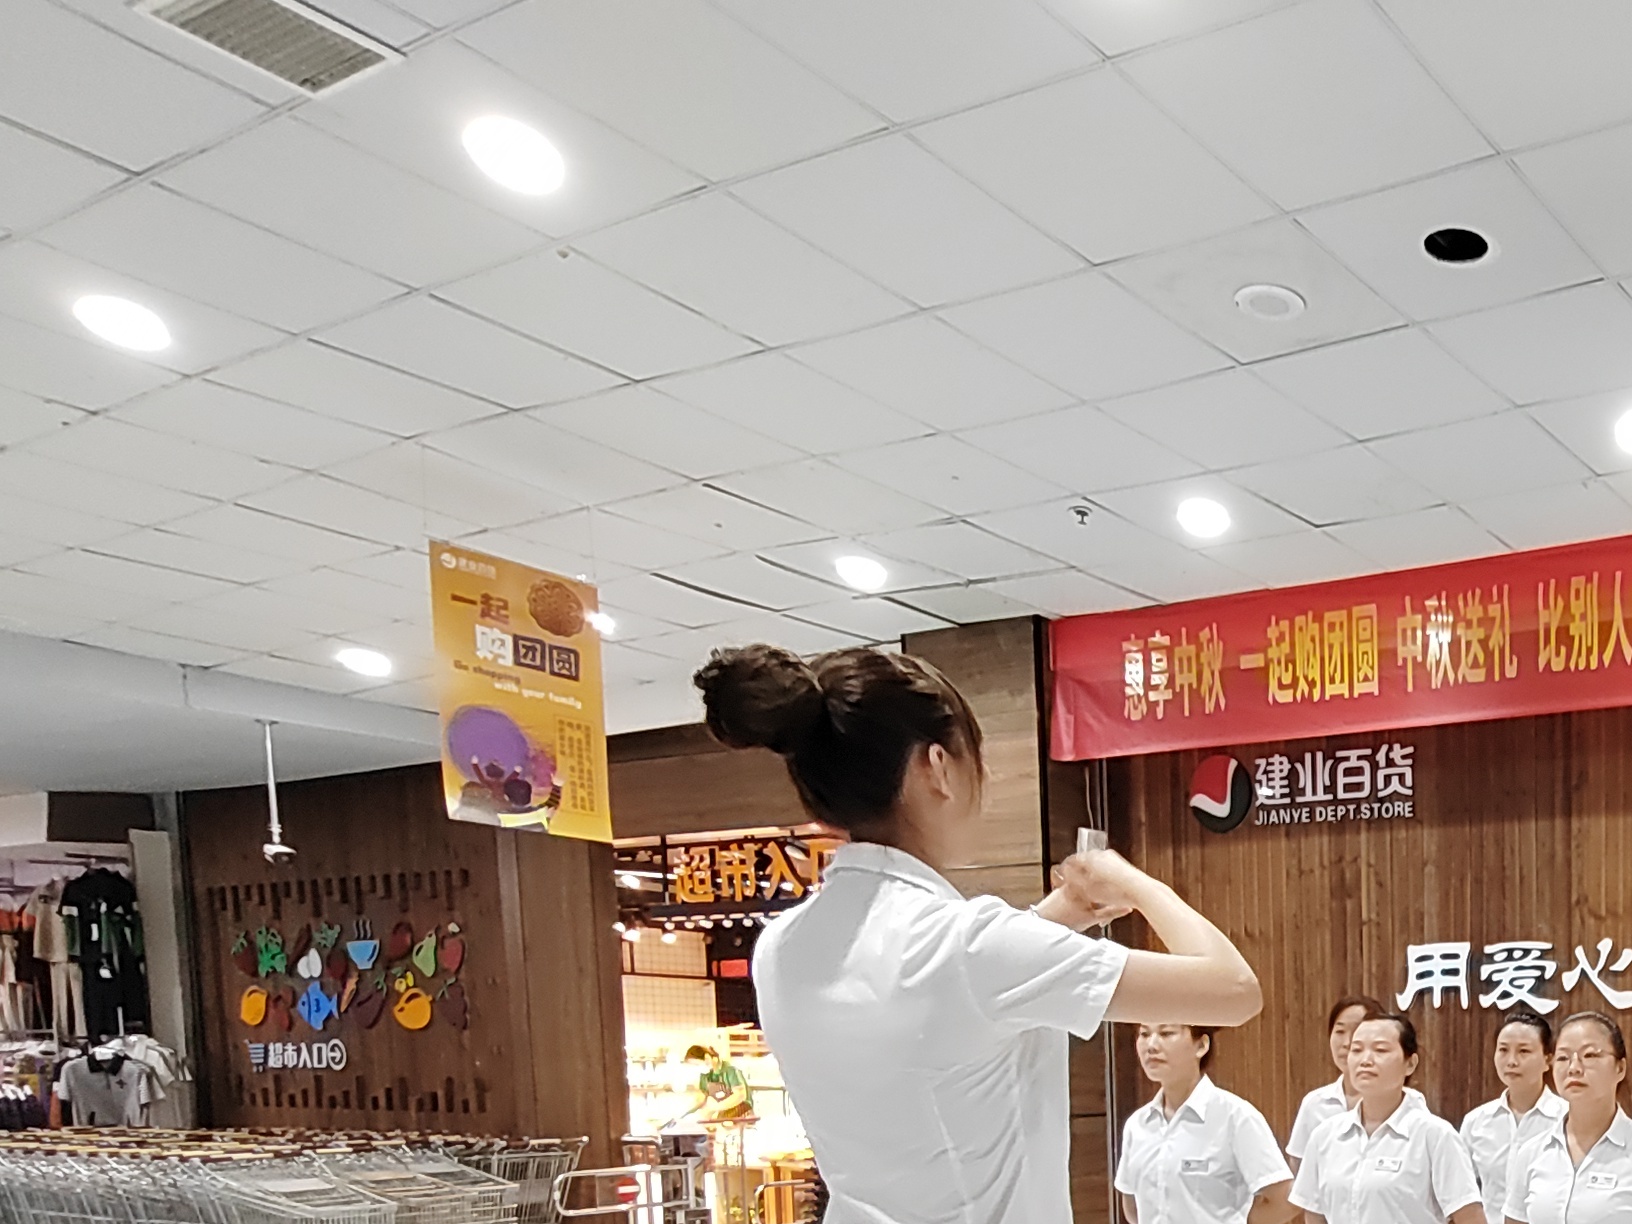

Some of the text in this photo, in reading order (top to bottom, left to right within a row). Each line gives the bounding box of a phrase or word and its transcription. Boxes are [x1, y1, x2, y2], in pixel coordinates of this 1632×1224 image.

[451, 593, 509, 626] 一起
[475, 623, 580, 682] 购团圆
[1122, 622, 1226, 721] 惠享中秋
[1239, 603, 1380, 706] 一起购团圆
[1397, 584, 1518, 692] 中秋送礼
[1254, 743, 1415, 806] 建业百货
[1255, 807, 1311, 826] JIANYE
[268, 1042, 328, 1069] 超市入口
